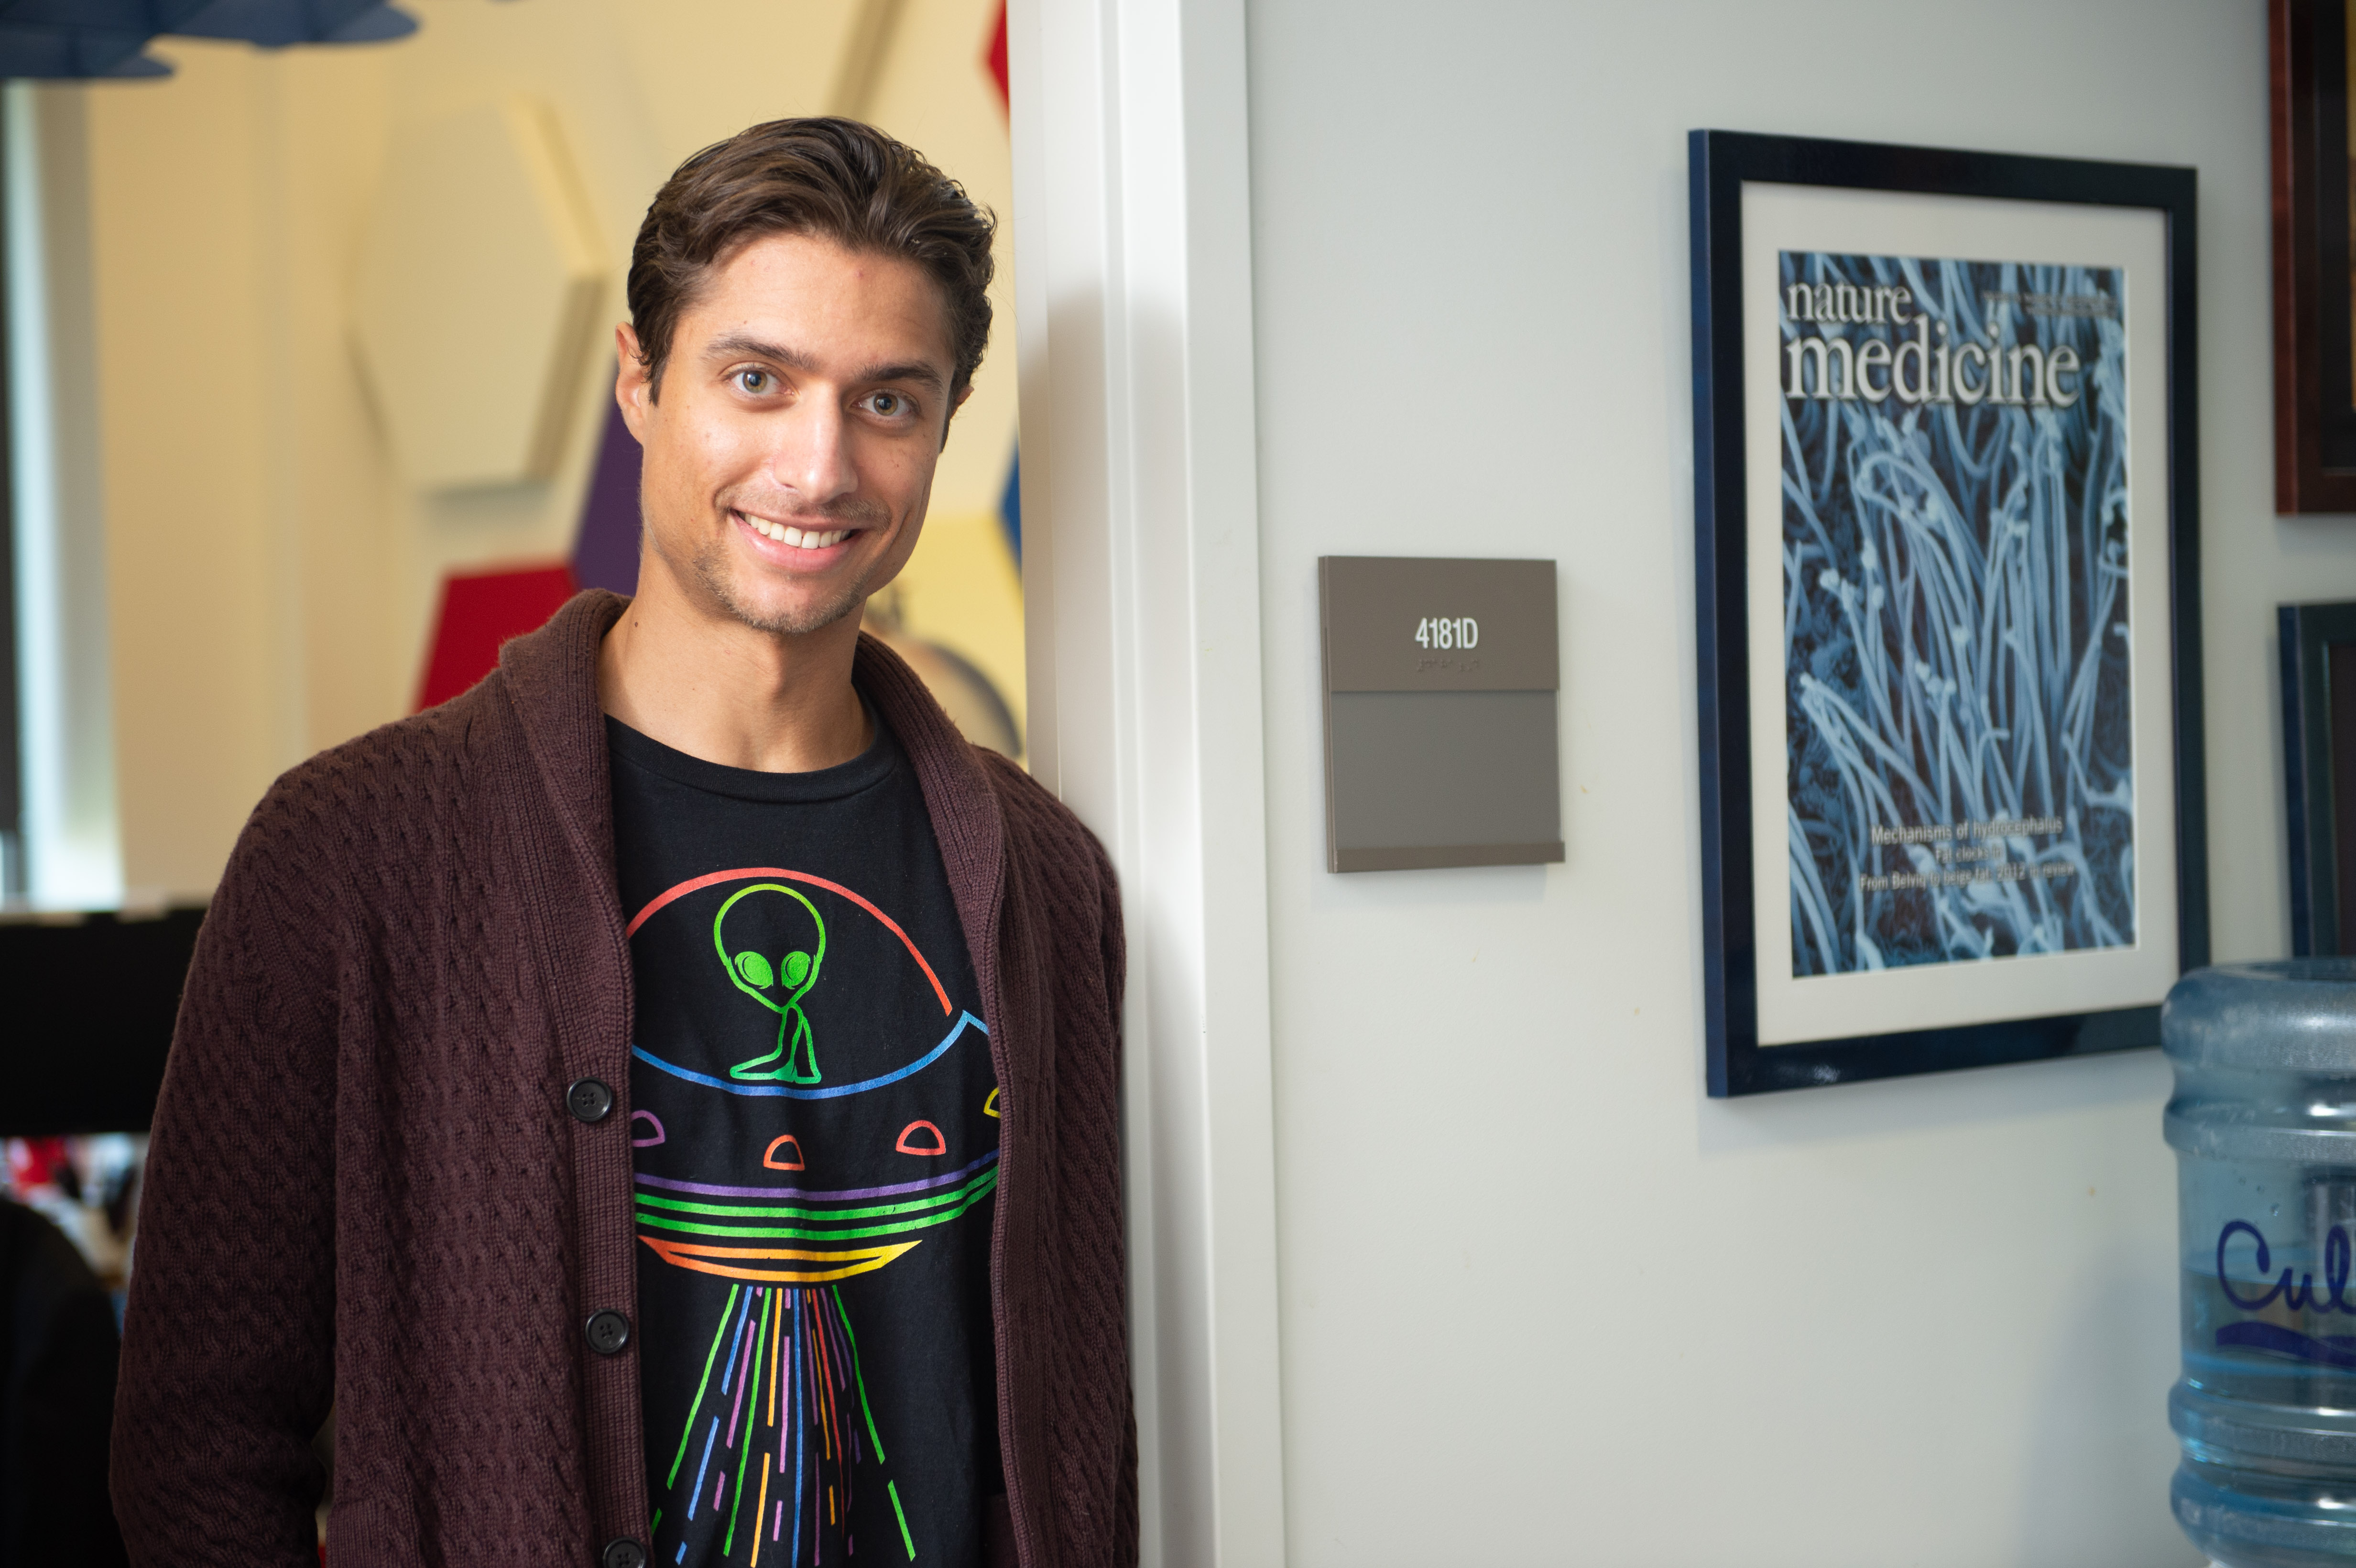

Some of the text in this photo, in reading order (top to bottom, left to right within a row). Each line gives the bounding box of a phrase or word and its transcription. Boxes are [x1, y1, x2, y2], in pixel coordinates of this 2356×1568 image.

[1786, 282, 1912, 325] nature
[1785, 313, 2080, 407] medicine
[1415, 617, 1479, 649] 4181D
[1871, 815, 2063, 845] Mechanisms of hydrocephalus
[1860, 873, 1888, 893] From
